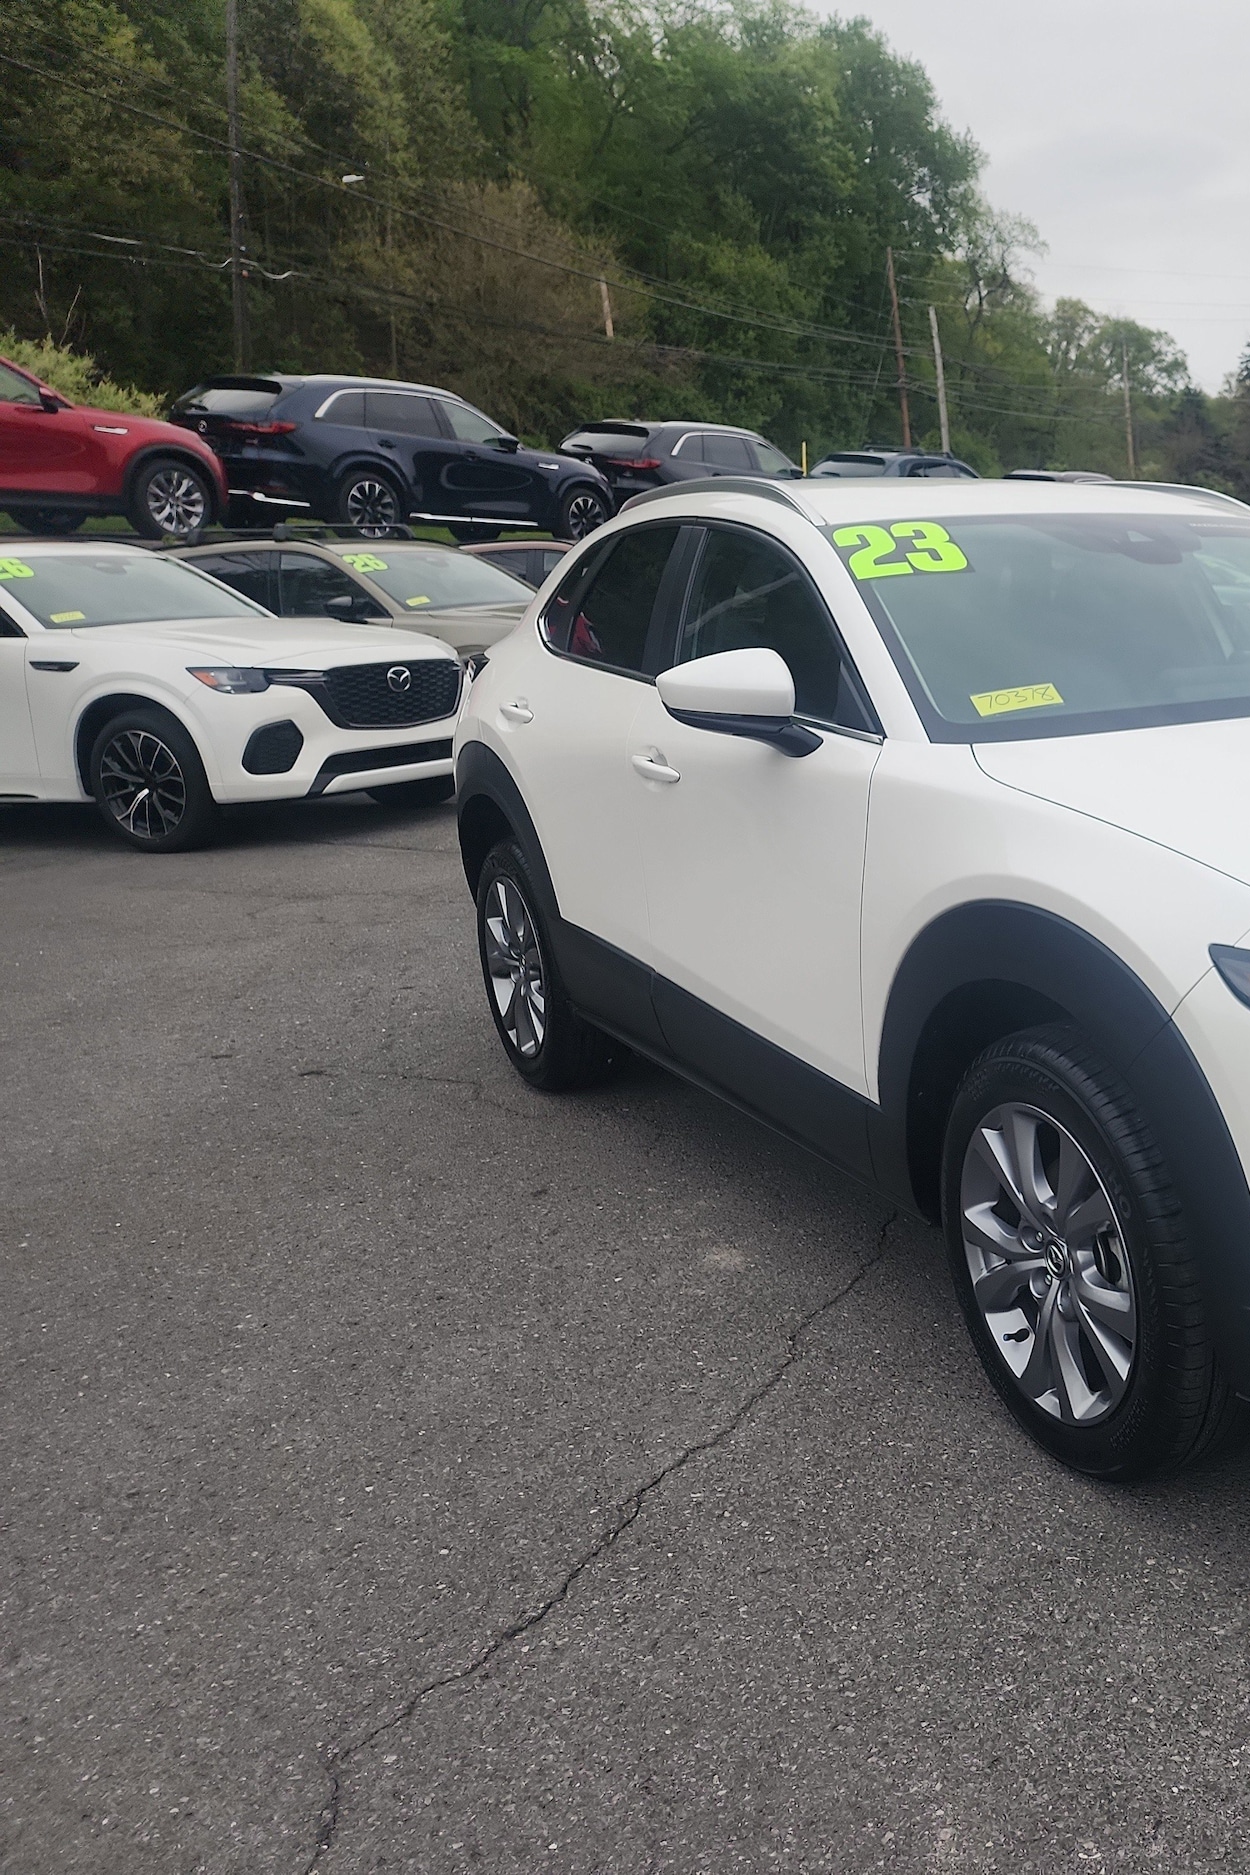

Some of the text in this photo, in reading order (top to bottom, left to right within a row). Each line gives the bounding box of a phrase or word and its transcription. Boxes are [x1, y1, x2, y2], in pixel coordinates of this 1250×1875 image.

[832, 521, 968, 580] 23
[342, 553, 389, 573] 26
[977, 685, 1055, 709] 70378
